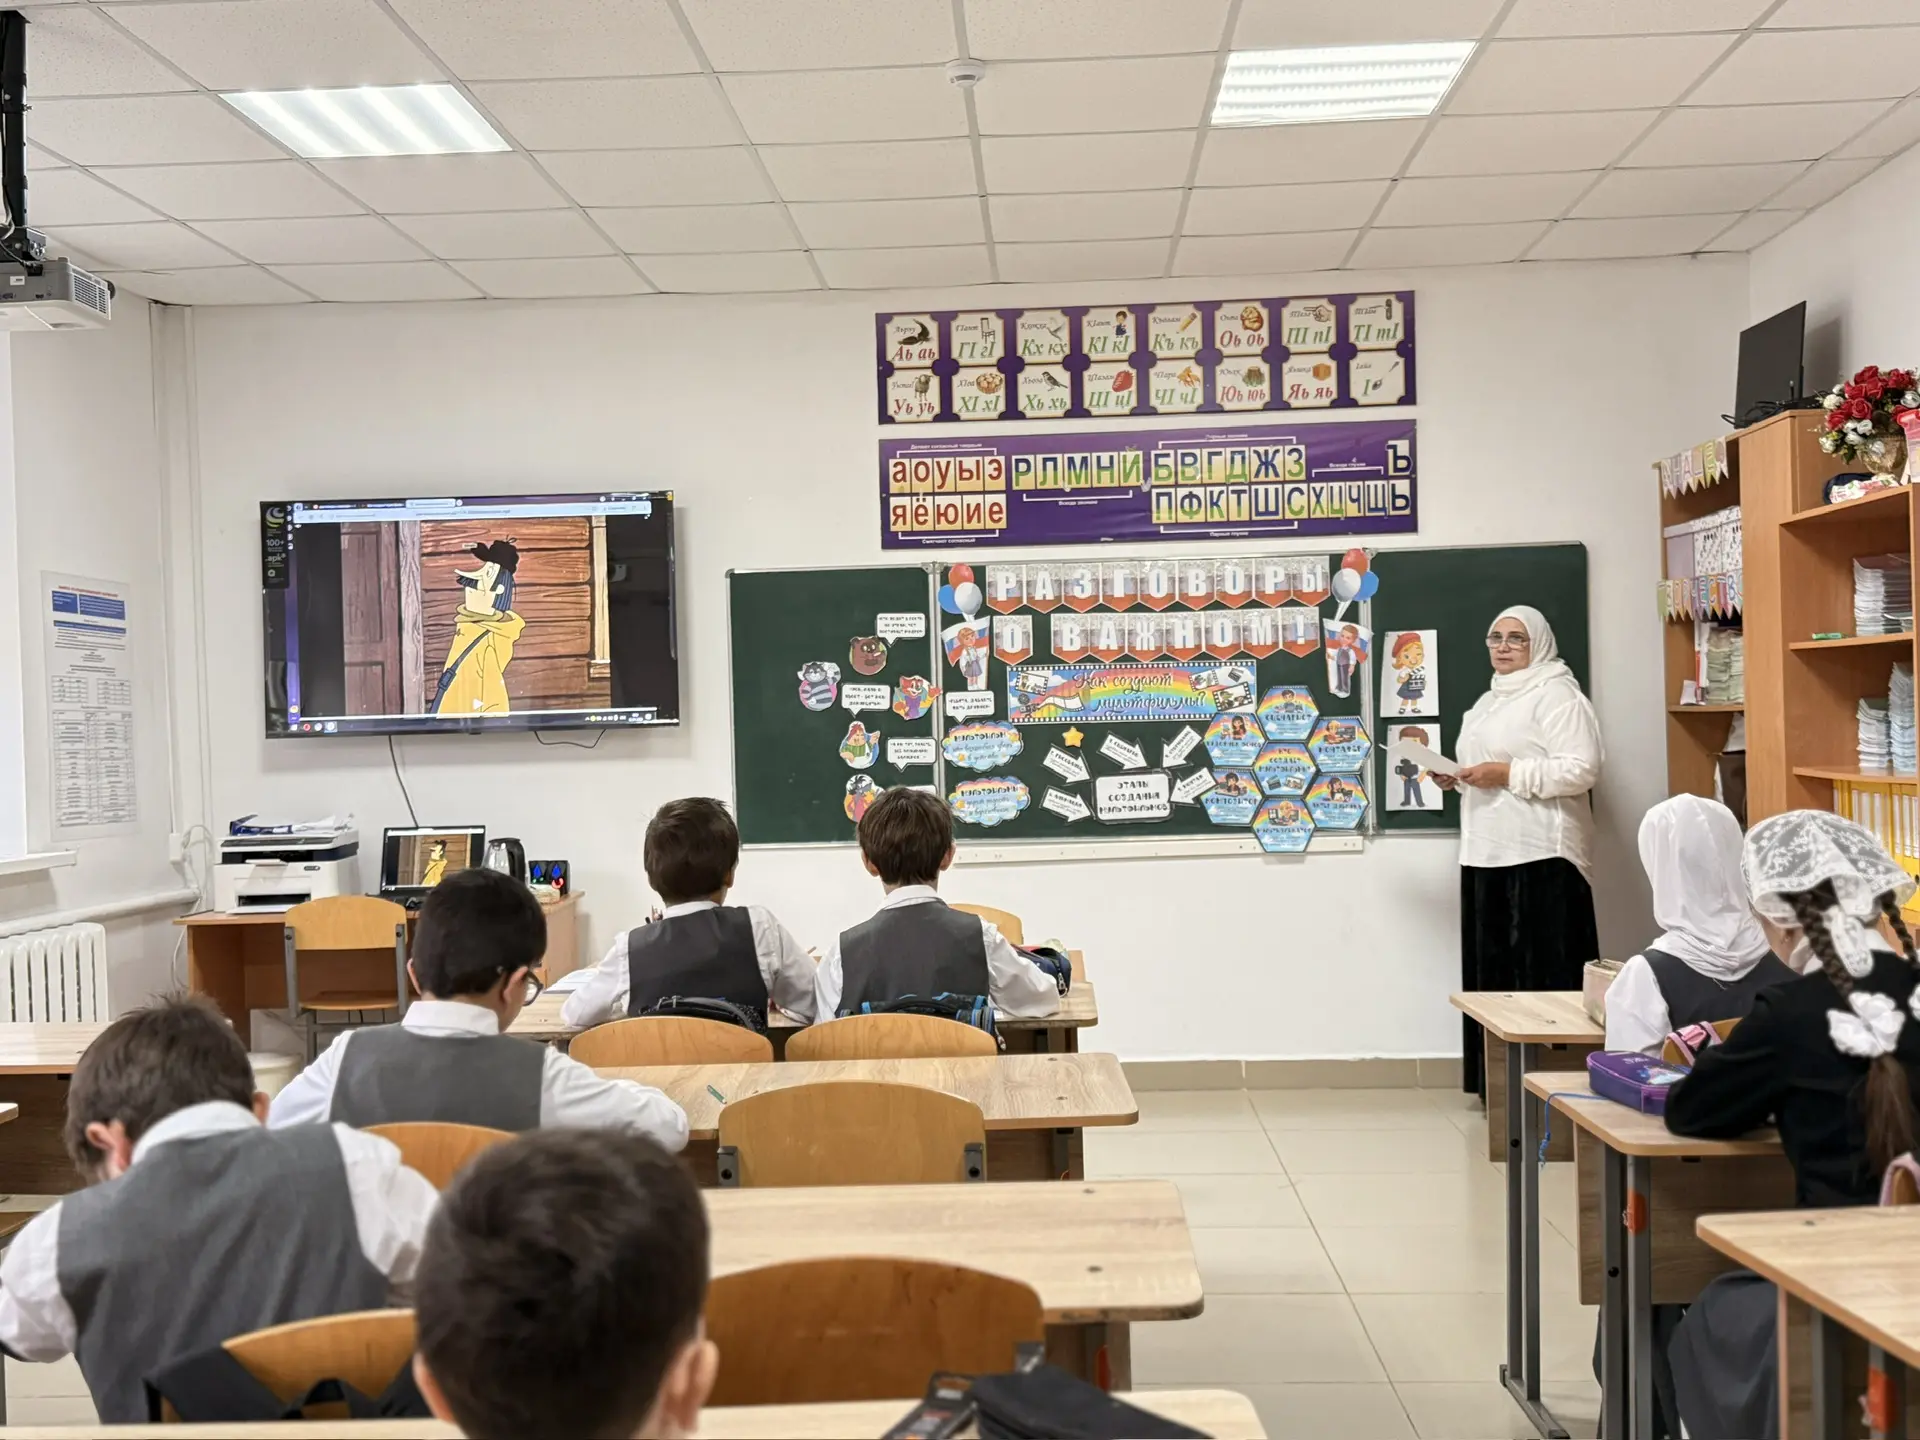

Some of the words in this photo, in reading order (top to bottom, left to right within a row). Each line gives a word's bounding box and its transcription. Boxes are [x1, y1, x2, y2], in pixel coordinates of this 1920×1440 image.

[1021, 338, 1043, 356] Кх
[1048, 343, 1067, 355] кх
[1152, 333, 1174, 351] Къ
[1179, 337, 1199, 350] къ
[1220, 330, 1242, 348] Оь
[1246, 334, 1265, 347] оь
[892, 345, 913, 361] Аь
[918, 348, 936, 360] аь
[1220, 386, 1243, 402] Юь
[1247, 389, 1266, 401] юь
[1287, 383, 1309, 400] Яь
[1314, 387, 1333, 399] яь
[894, 398, 913, 415] Уь
[916, 402, 935, 418] уь
[1023, 394, 1044, 411] Хь
[1048, 397, 1067, 410] хь
[996, 564, 1324, 602] РАЗГОВОРЫ
[1003, 623, 1022, 653] О
[1062, 614, 1306, 651] ВАЖНОМ!
[1072, 671, 1107, 690] Как
[1113, 672, 1174, 695] создают
[1091, 691, 1206, 716] мультфильмы?
[1117, 780, 1149, 790] ЭТАПЫ
[1108, 791, 1160, 802] СОЗДАНИЯ
